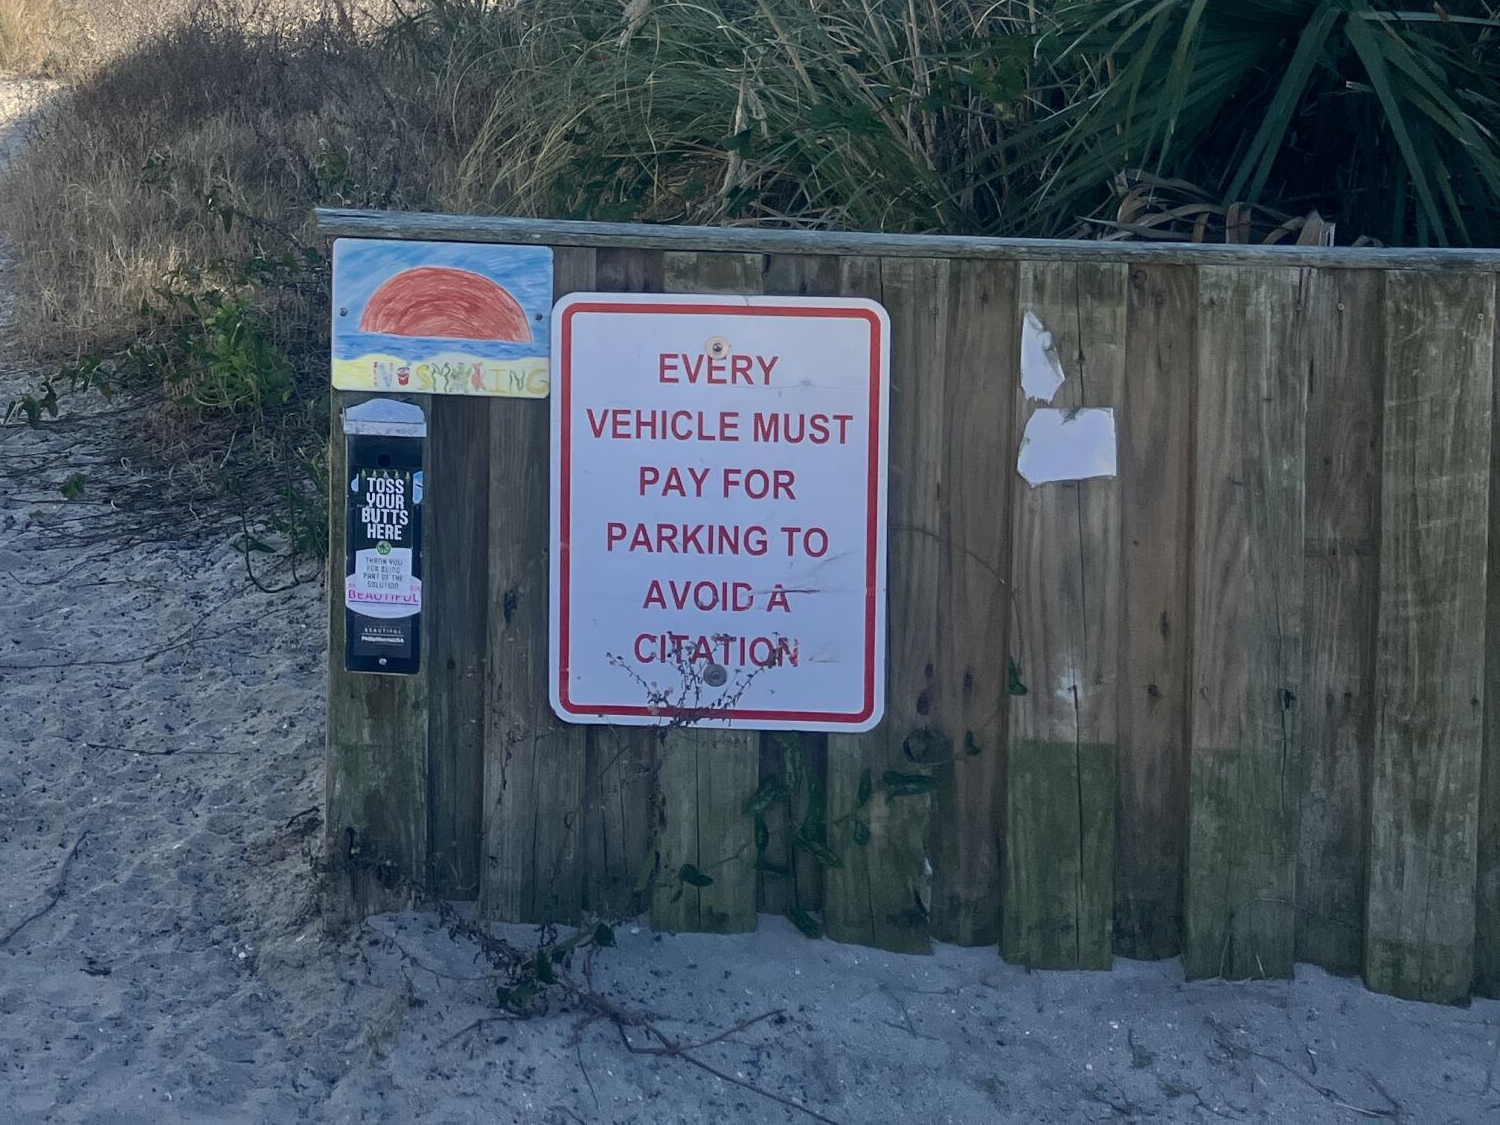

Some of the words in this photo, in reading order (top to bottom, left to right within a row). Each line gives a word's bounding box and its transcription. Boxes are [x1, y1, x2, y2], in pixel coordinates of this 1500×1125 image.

[659, 353, 779, 385] EVERY
[586, 408, 739, 441] VEHICLE
[753, 413, 853, 444] MUST
[367, 478, 404, 494] TOSS
[639, 467, 710, 497] PAY
[723, 469, 796, 500] FOR
[362, 508, 408, 525] BUTTS
[366, 492, 404, 509] YOUR
[367, 523, 402, 540] HERE
[607, 522, 768, 556] PARKING
[781, 527, 828, 557] TO
[366, 557, 386, 565] THANK
[643, 580, 754, 611] AVOID
[766, 584, 791, 612] A
[634, 633, 798, 667] CITATION
